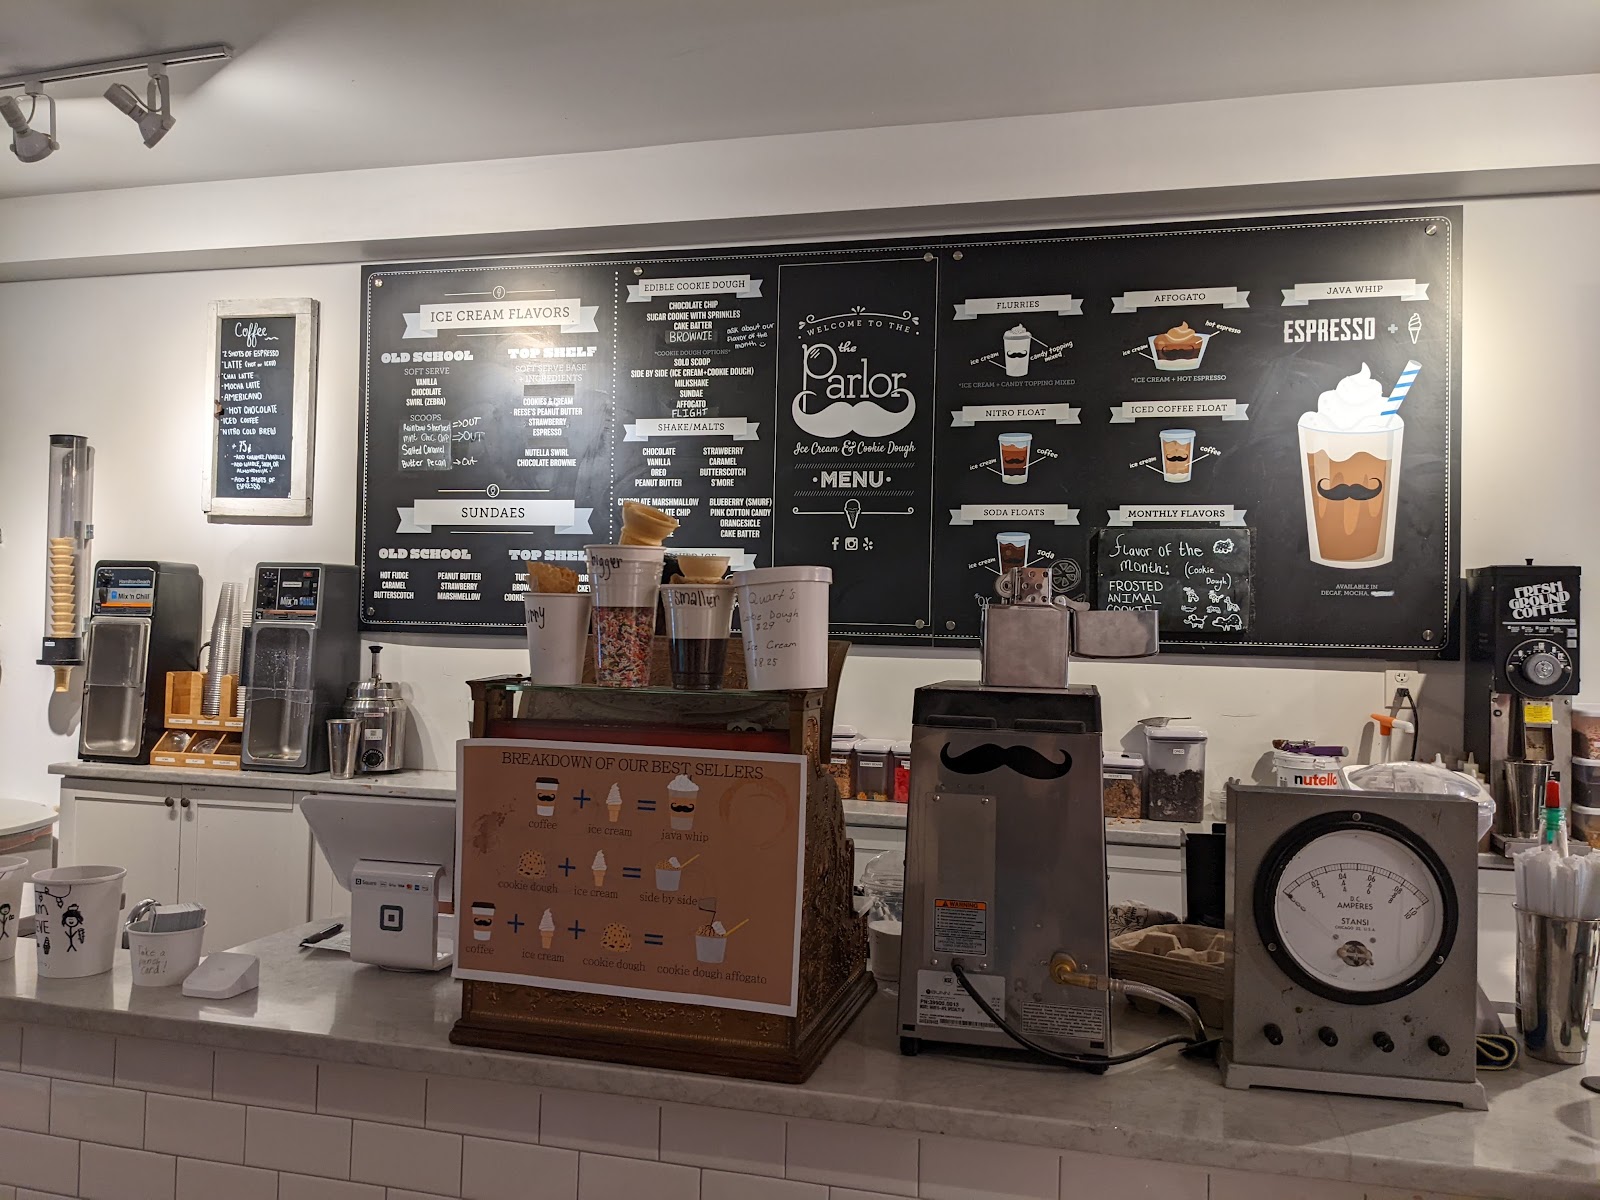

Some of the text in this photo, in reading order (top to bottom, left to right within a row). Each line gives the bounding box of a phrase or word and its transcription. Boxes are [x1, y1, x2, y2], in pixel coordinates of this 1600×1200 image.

[677, 282, 710, 290] COOKIE
[713, 280, 745, 288] DOUGH
[1155, 293, 1206, 302] AFFOGATO
[669, 300, 718, 310] CHOCOLATE CHIP
[997, 301, 1040, 309] FLURRIES
[431, 307, 570, 322] ICE CREAM FLAVORS
[647, 310, 740, 321] SUGAR COOKIE WITH SPRINKLES
[674, 322, 689, 330] CAKE
[807, 320, 862, 336] WELCOME
[889, 322, 911, 333] THE
[1205, 320, 1241, 334] hot espresso
[1284, 317, 1375, 342] ESPRESSO
[235, 322, 267, 347] Coffee
[670, 331, 712, 342] BROWNIE
[838, 341, 856, 352] the
[381, 351, 473, 363] OLD SCHOOL
[508, 347, 597, 359] TOP SHELF
[674, 358, 710, 366] SOLO SCOOP
[416, 378, 437, 386] VANILLA
[675, 379, 709, 387] MILKSHAKE
[802, 344, 907, 412] Parlor
[224, 392, 262, 401] AMERICANO
[411, 388, 441, 396] CHOCOLATE
[680, 390, 703, 398] SUNDAE
[406, 398, 446, 406] SWIRL (ZEBRA)
[676, 400, 706, 408] AFFOGATO
[244, 405, 277, 414] CHOCOLATE
[514, 408, 536, 416] REESE'S
[672, 408, 708, 417] FLIGHT
[1132, 406, 1154, 414] ICED
[1197, 404, 1227, 412] FLOAT
[259, 427, 276, 435] BREW
[532, 428, 561, 436] ESPRESSO
[658, 423, 725, 431] SHAKE/MALTS
[703, 447, 743, 455] STRAWBERRY
[794, 440, 916, 458] Ice Cream & Cookie Dough
[1037, 448, 1058, 458] coffee
[1200, 446, 1221, 456] coffee
[517, 459, 576, 467] CHOCOLATE BROWNIE
[700, 468, 746, 476] BUTTERSCOTCH
[635, 479, 658, 487] PEANUT
[821, 471, 884, 488] MENU
[709, 498, 772, 506] BLUEBERRY (SMURF)
[462, 508, 524, 518] SUNDAES
[710, 509, 771, 517] PINK COTTON CANDY
[1037, 549, 1054, 559] soda
[1158, 542, 1171, 557] of
[1179, 542, 1203, 556] the
[382, 581, 406, 589] CARAMEL
[1109, 581, 1163, 591] FROSTED
[1514, 581, 1562, 598] FRESH
[1108, 593, 1161, 604] ANIMAL
[1509, 591, 1570, 609] GROUND
[1512, 603, 1567, 619] COFFEE
[502, 752, 763, 780] BREAKDOWN OF OUR BEST SELLERS
[529, 820, 557, 830] coffee
[588, 825, 632, 836] ice cream
[660, 830, 708, 842] java whip
[498, 880, 558, 894] cookie dough
[639, 892, 697, 906] side by side
[1337, 902, 1373, 910] AMPERES
[657, 964, 767, 984] cookie dough affogato
